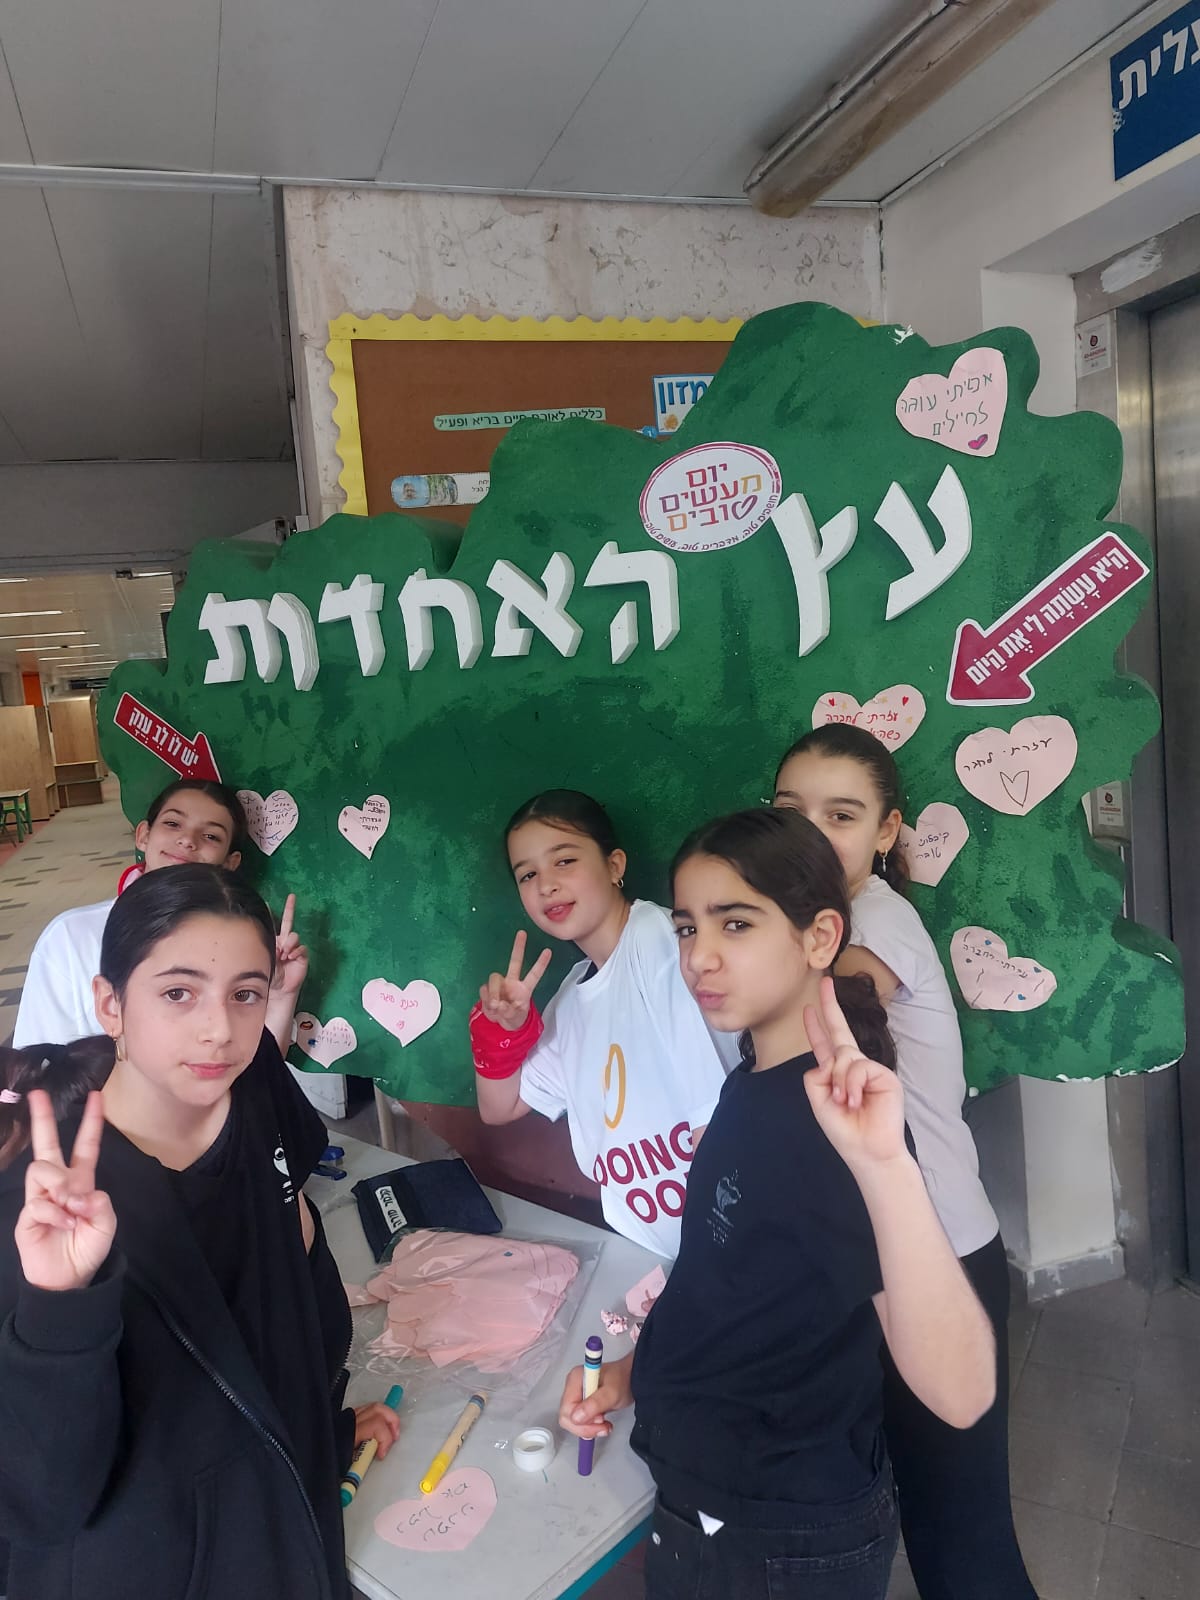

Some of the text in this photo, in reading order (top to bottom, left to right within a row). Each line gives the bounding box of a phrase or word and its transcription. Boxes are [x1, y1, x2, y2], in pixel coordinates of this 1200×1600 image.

[1118, 18, 1200, 110] לית
[472, 415, 500, 425] בריא
[659, 474, 763, 513] מעשים
[686, 463, 728, 488] יום
[198, 464, 973, 692] עץ האחדות
